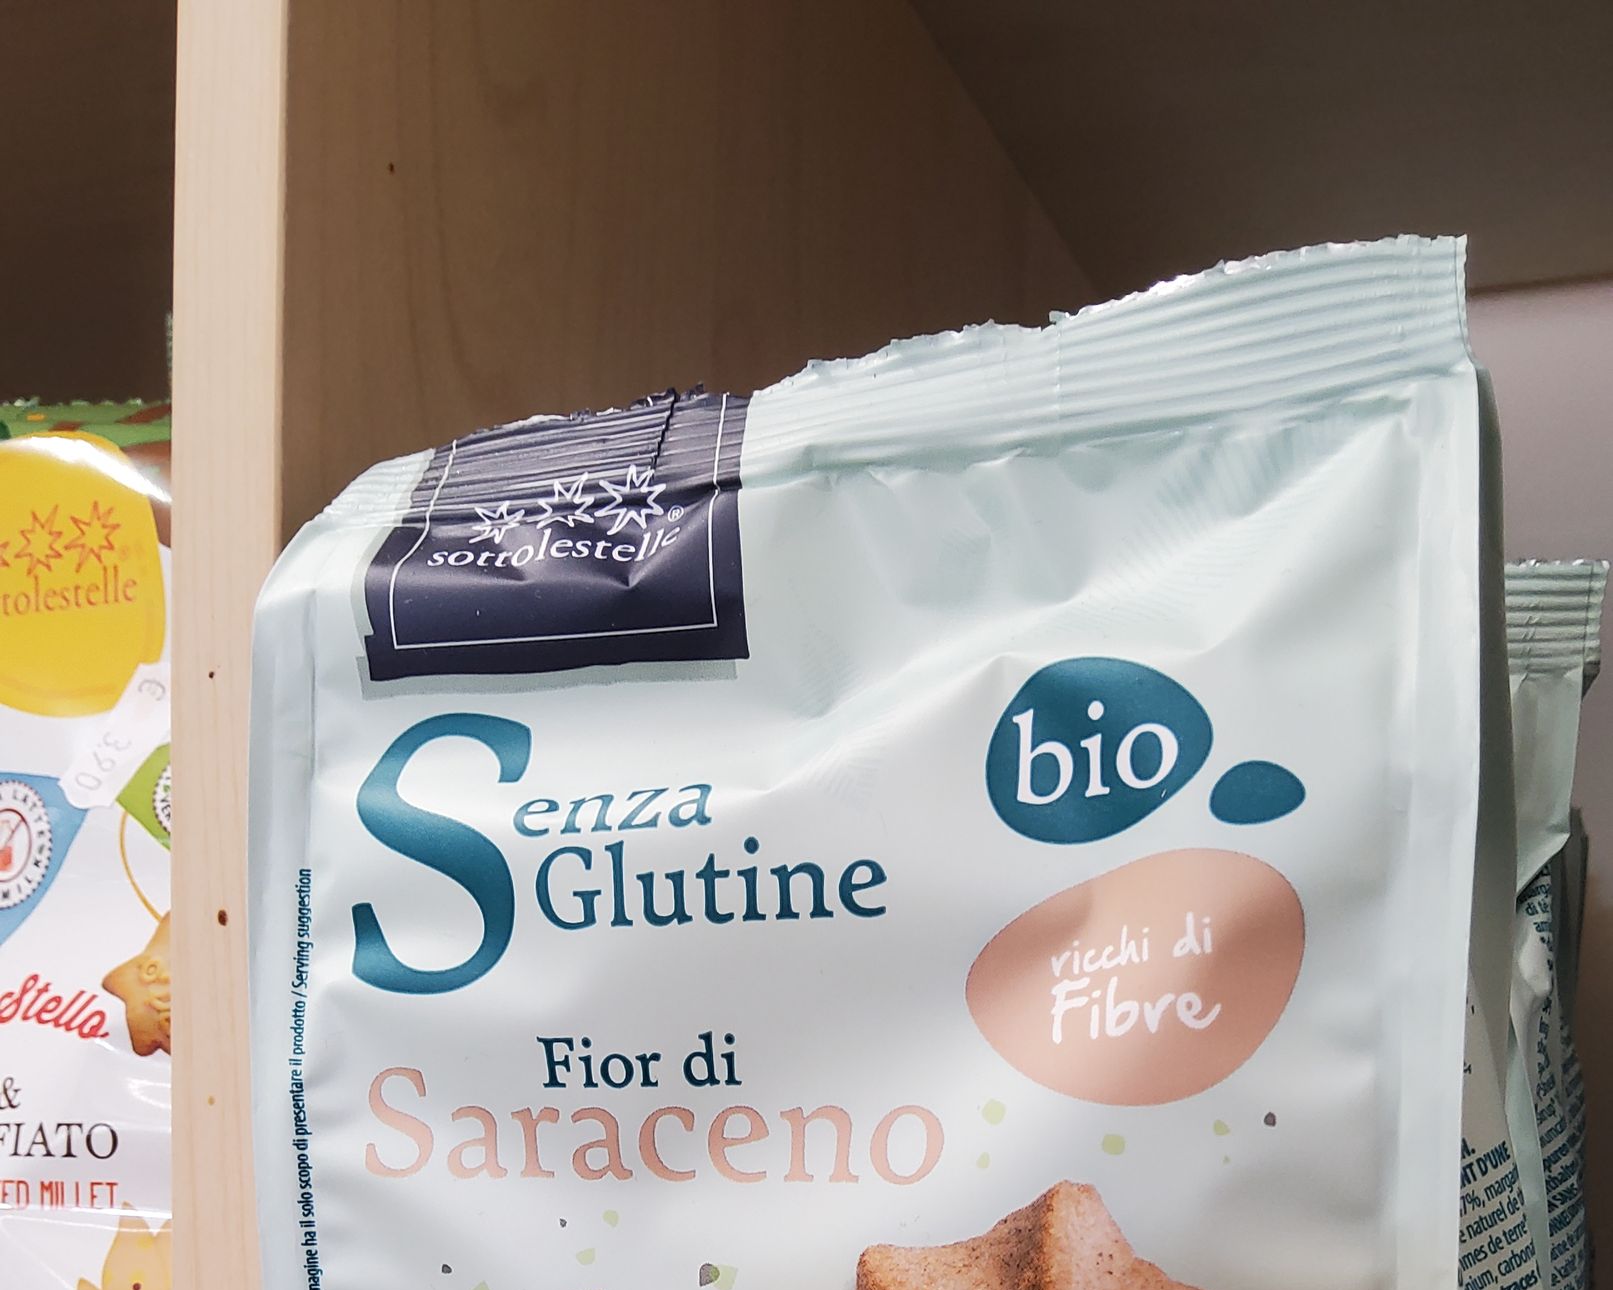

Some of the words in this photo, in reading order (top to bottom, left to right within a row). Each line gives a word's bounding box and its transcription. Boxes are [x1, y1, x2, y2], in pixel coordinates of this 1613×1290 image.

[427, 525, 681, 569] sottolestelle
[1012, 700, 1179, 805] bio
[295, 868, 313, 938] suggestion
[535, 837, 888, 931] Glutine
[292, 941, 314, 989] Serving
[1052, 925, 1150, 978] ricchi
[1172, 912, 1213, 959] di
[290, 1000, 307, 1055] prodotto
[1051, 976, 1222, 1045] Fibre
[288, 1058, 304, 1066] il
[536, 1035, 662, 1088] Fior
[682, 1031, 743, 1087] di
[289, 1069, 313, 1136] presentare
[364, 1066, 946, 1186] Saraceno
[292, 1139, 309, 1151] di
[297, 1154, 314, 1190] scopo
[297, 1192, 314, 1217] solo
[299, 1220, 316, 1228] il
[1466, 1201, 1508, 1240] naturel
[1507, 1195, 1520, 1215] de
[301, 1231, 317, 1246] ha
[1488, 1235, 1504, 1254] de
